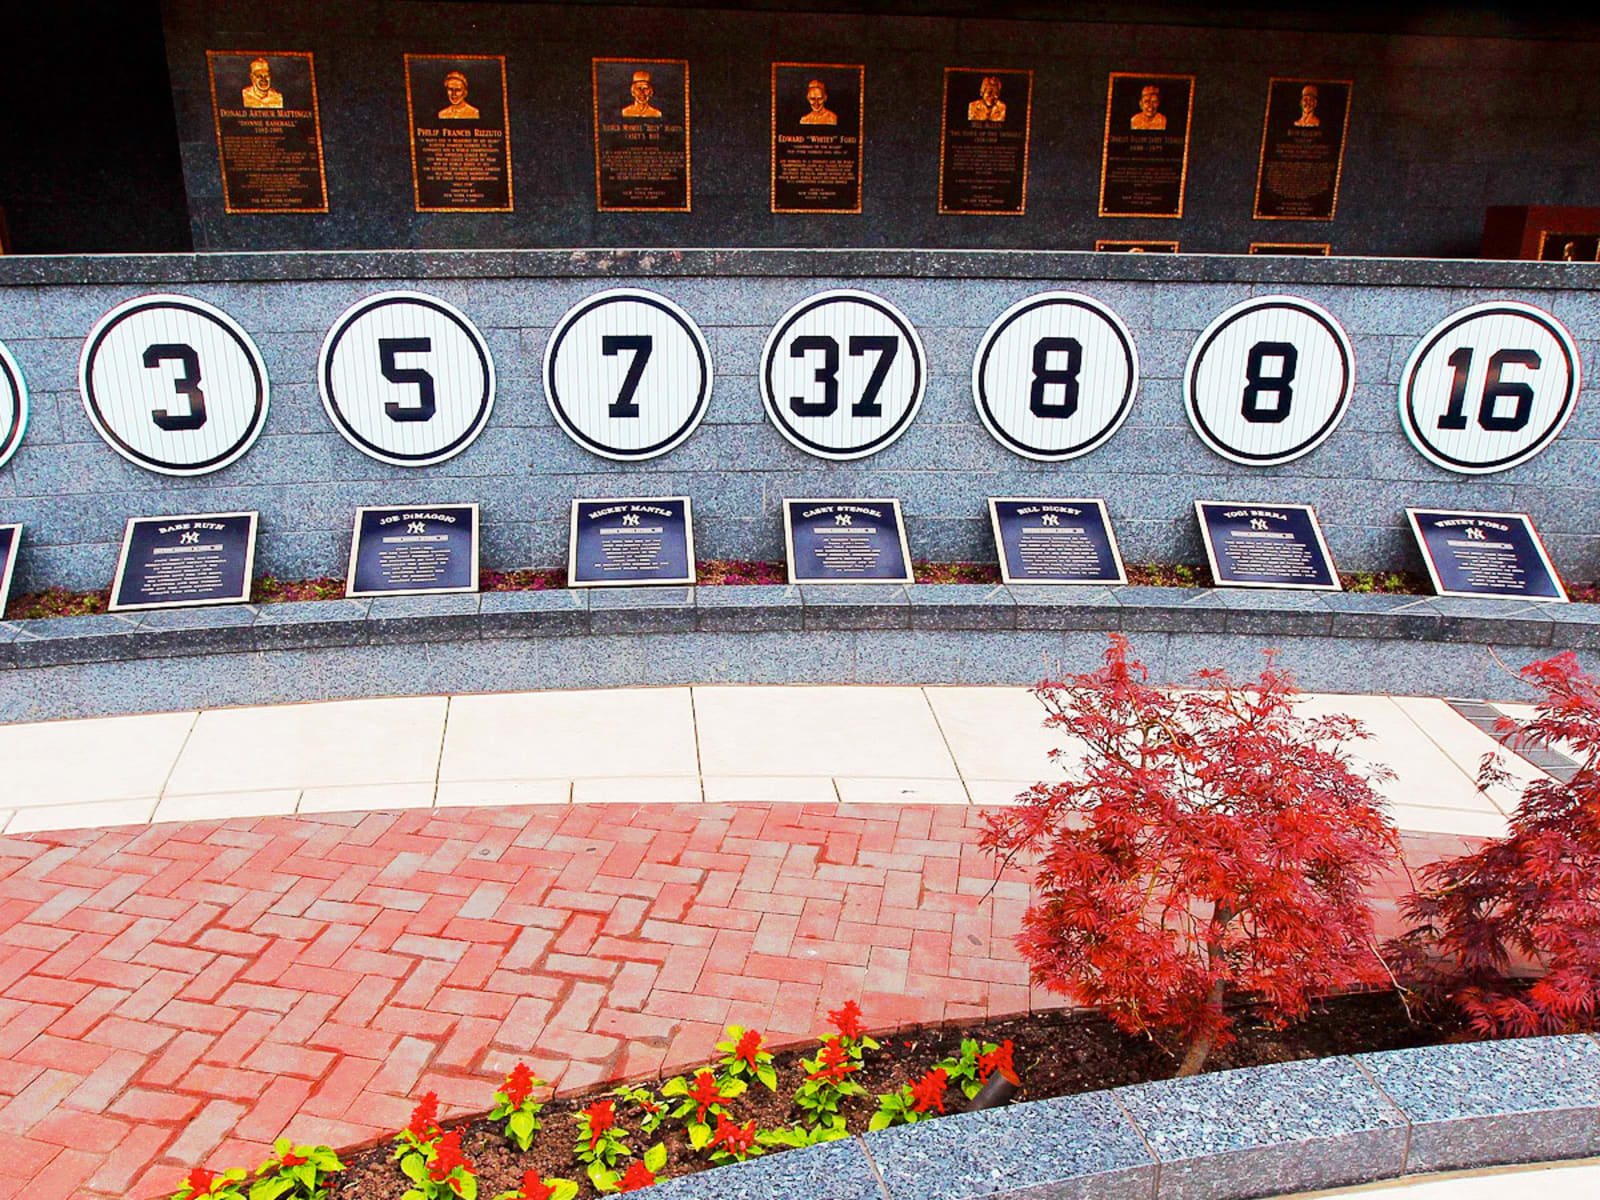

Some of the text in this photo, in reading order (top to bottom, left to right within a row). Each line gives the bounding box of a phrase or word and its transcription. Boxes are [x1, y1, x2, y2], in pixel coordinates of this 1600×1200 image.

[221, 108, 248, 117] DONALD
[250, 109, 276, 117] ARTHUR
[417, 128, 502, 137] PHILIP FRANCIS RIZZUTO
[778, 135, 805, 143] EDWARD
[379, 338, 435, 422] 5
[603, 336, 652, 417] 7
[791, 336, 898, 417] 37
[1030, 337, 1082, 418] 8
[1242, 342, 1297, 423] 8
[143, 344, 206, 430] 3
[1438, 348, 1541, 431] 16
[588, 505, 673, 519] MICKEY MANTLE
[802, 506, 882, 518] CASEY STENGEL
[1016, 505, 1082, 515] BILL DICKEY
[1250, 510, 1287, 520] BERRA
[379, 515, 400, 525] JOE
[1434, 519, 1510, 531] WHITEY FORD
[158, 522, 226, 534] BABE RUTH
